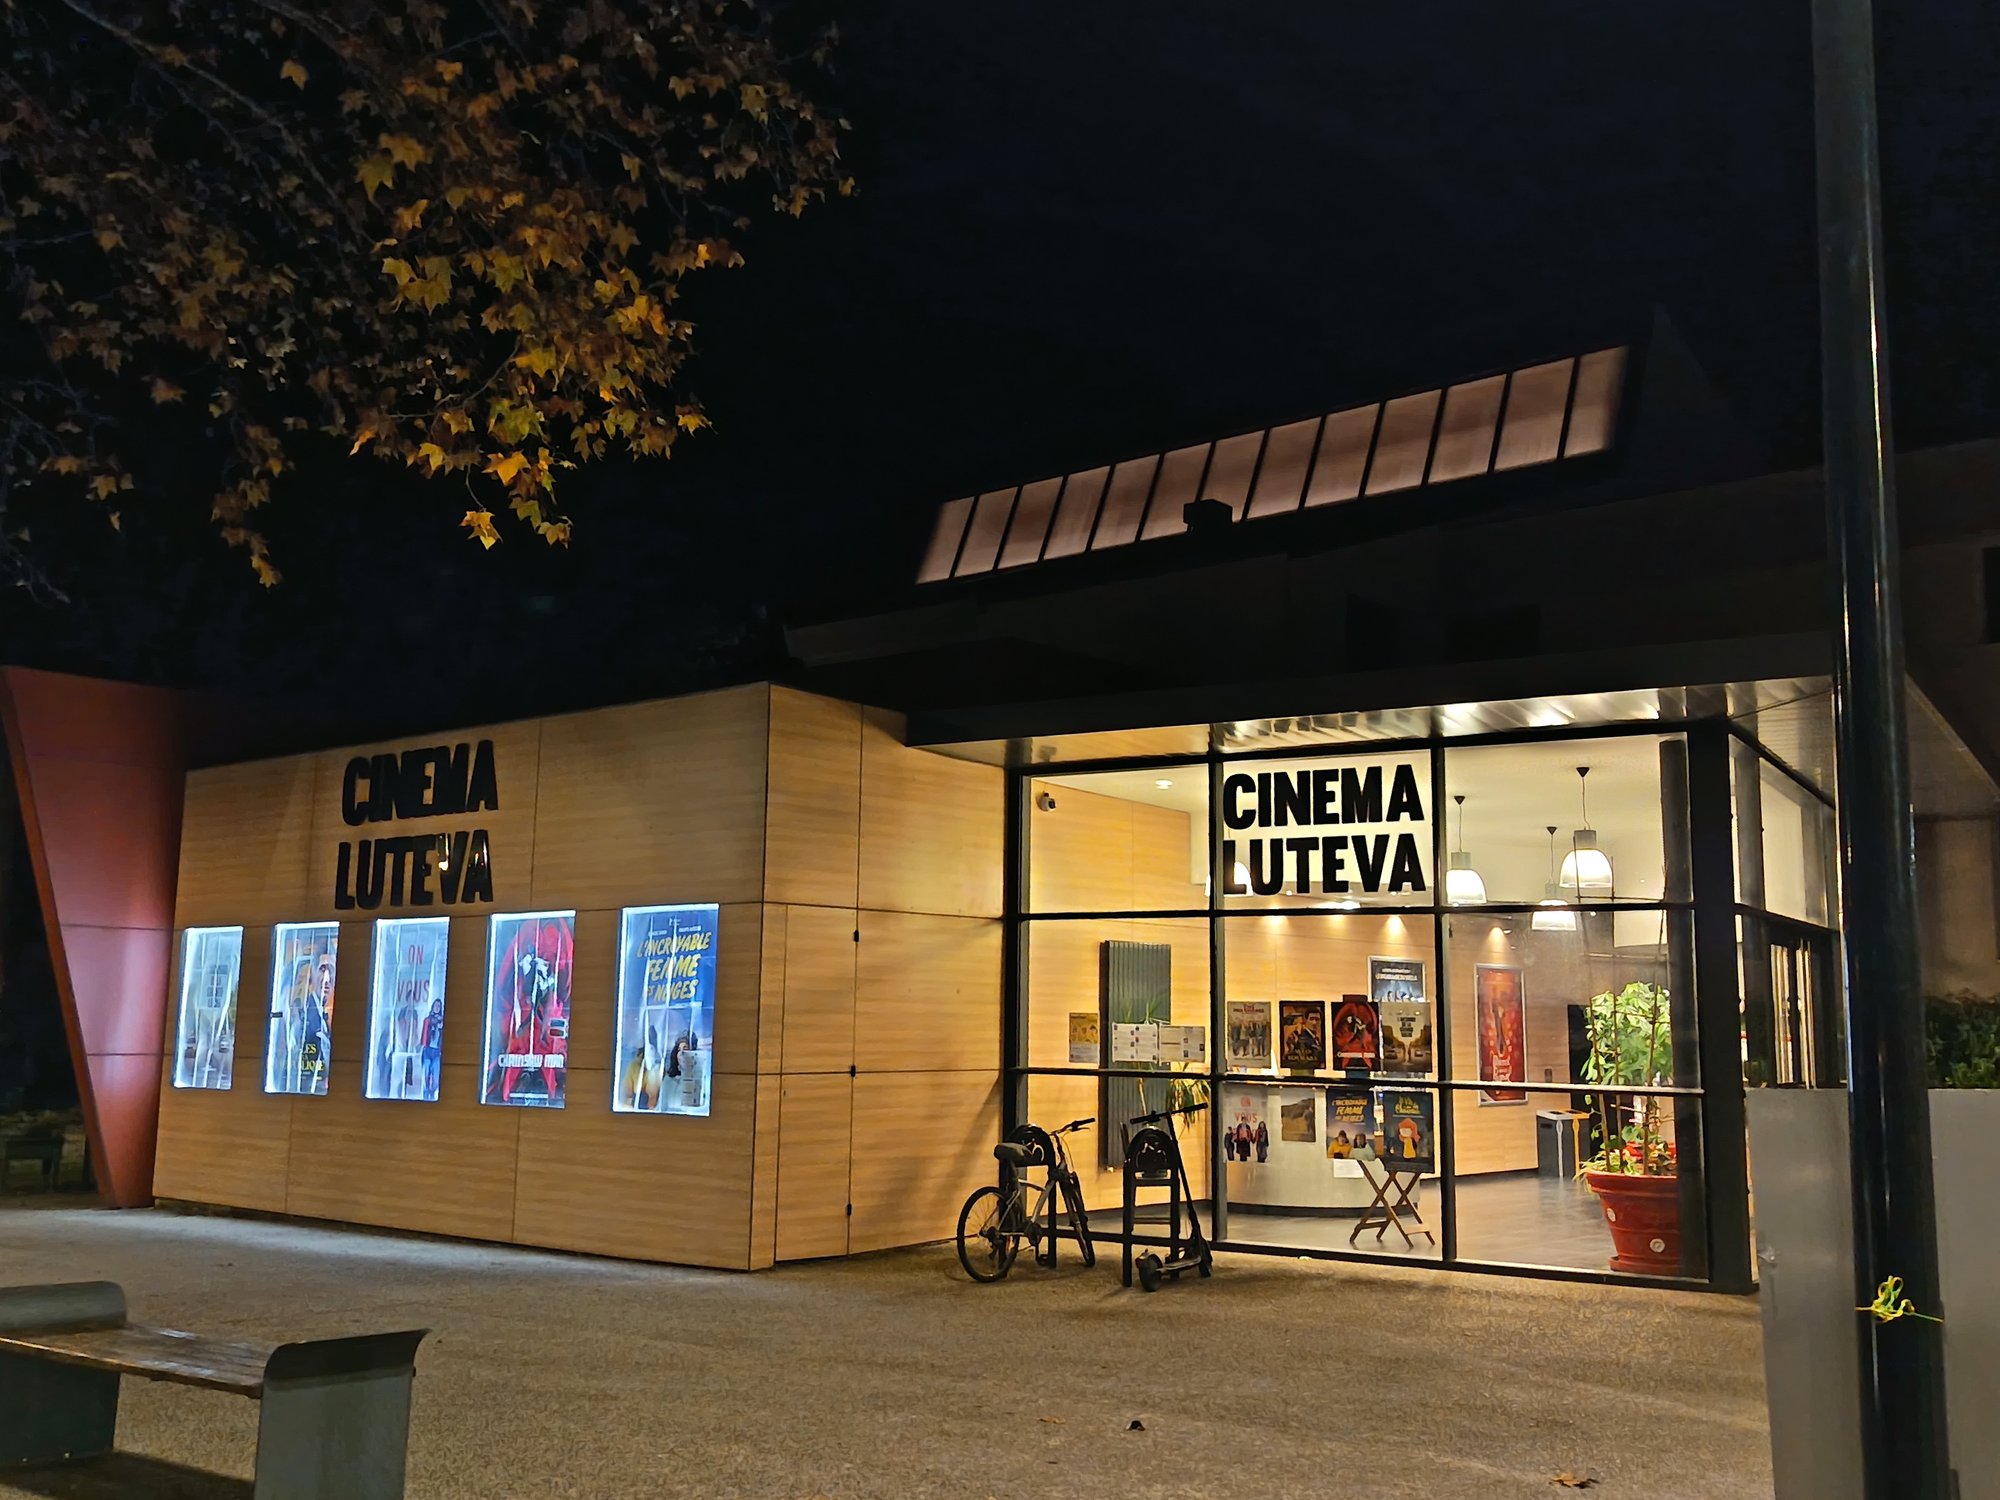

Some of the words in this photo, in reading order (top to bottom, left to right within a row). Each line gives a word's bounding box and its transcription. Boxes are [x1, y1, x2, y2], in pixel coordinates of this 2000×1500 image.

[342, 739, 499, 826] CINEMA
[1222, 764, 1424, 830] CINEMA
[334, 829, 494, 910] LUTEVA
[1222, 833, 1426, 896] LUTEVA
[408, 944, 424, 965] ON
